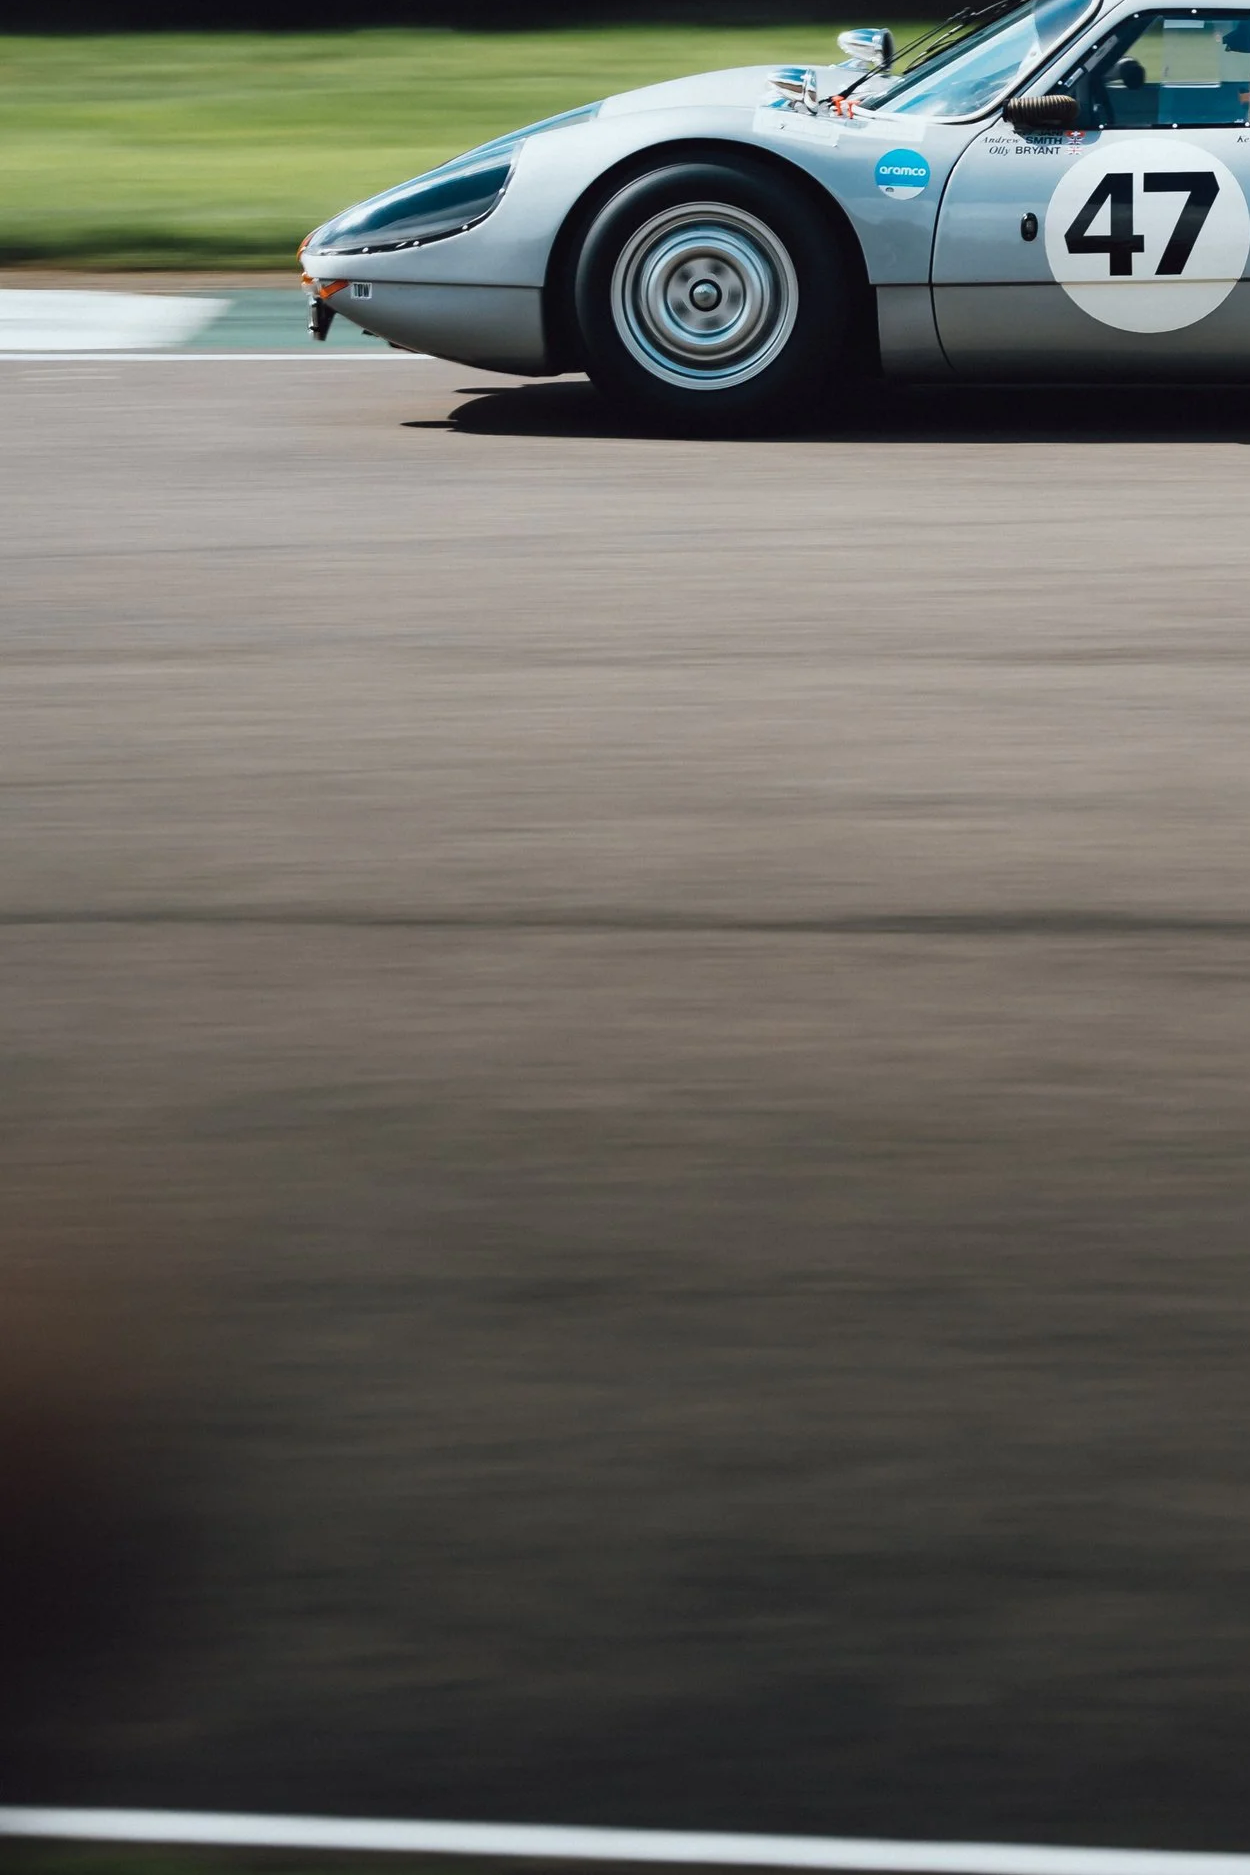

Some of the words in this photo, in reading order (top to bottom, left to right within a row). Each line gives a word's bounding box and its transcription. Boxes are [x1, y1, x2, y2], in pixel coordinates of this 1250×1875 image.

[982, 136, 1020, 144] Andrew
[1025, 136, 1063, 145] SMITH
[989, 145, 1011, 156] Olly
[1015, 146, 1061, 155] BRYANT
[880, 166, 926, 176] aramco
[1064, 171, 1220, 276] 47
[353, 283, 370, 297] TOW
